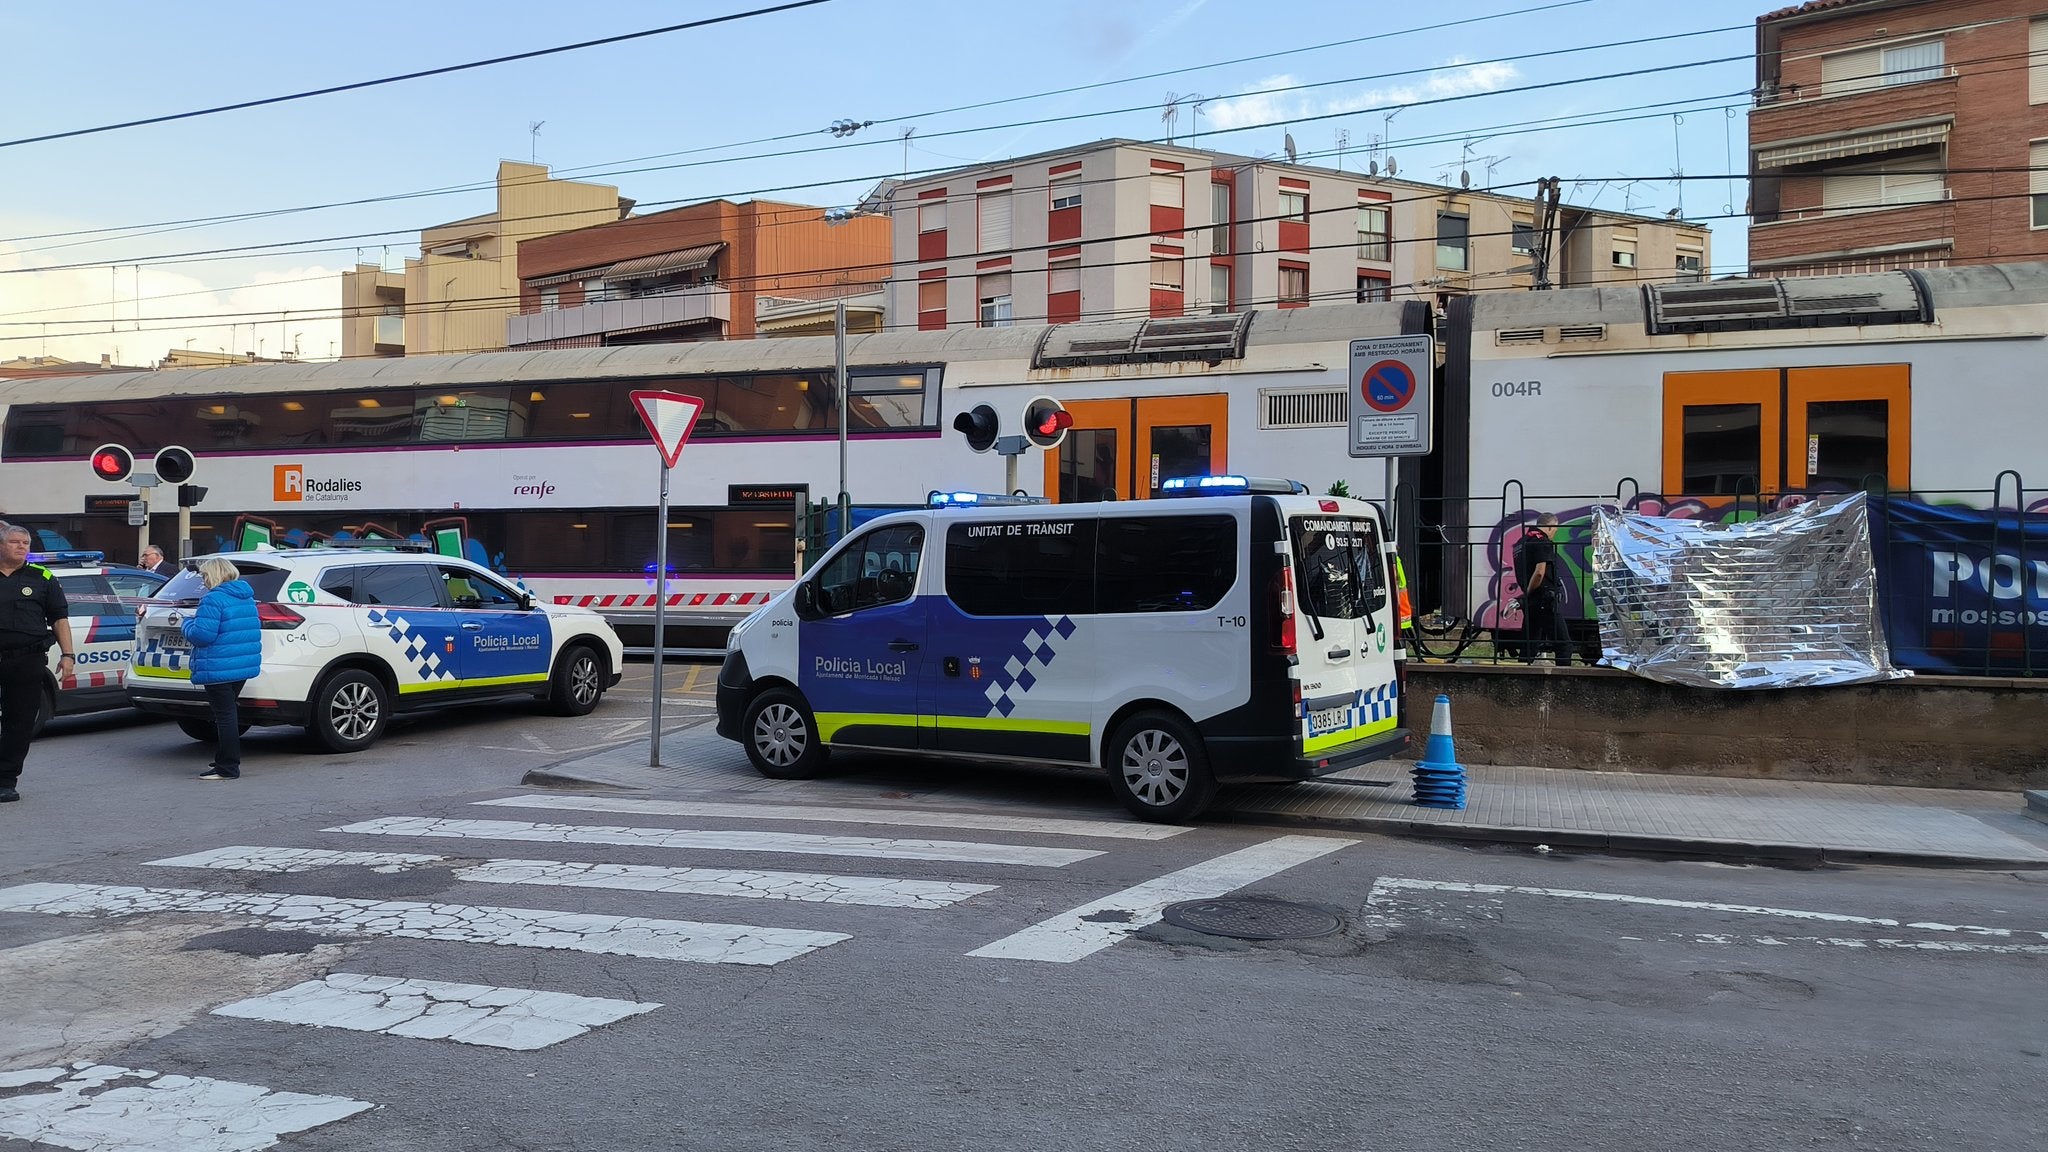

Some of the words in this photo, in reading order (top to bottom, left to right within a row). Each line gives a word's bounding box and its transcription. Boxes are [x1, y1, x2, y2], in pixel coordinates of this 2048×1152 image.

[1367, 349, 1400, 357] RESTRICCIÓ
[1491, 381, 1542, 398] 004R
[306, 478, 362, 492] Rodalies
[513, 480, 556, 500] renfe
[305, 493, 315, 501] de
[315, 493, 349, 503] Catalunya
[968, 525, 1004, 538] UNITAT
[1006, 524, 1022, 536] DE
[1026, 521, 1075, 535] TRÀNSIT
[1303, 519, 1351, 532] COMANDAMENT
[771, 618, 793, 627] policia
[1217, 615, 1246, 628] T-10
[164, 634, 183, 647] 1686
[286, 633, 307, 643] C-4
[474, 635, 508, 648] Policia
[512, 633, 540, 646] Local
[815, 656, 862, 673] Policia
[867, 658, 906, 675] Local
[1312, 712, 1332, 729] 0385
[1333, 708, 1346, 726] LRJ
